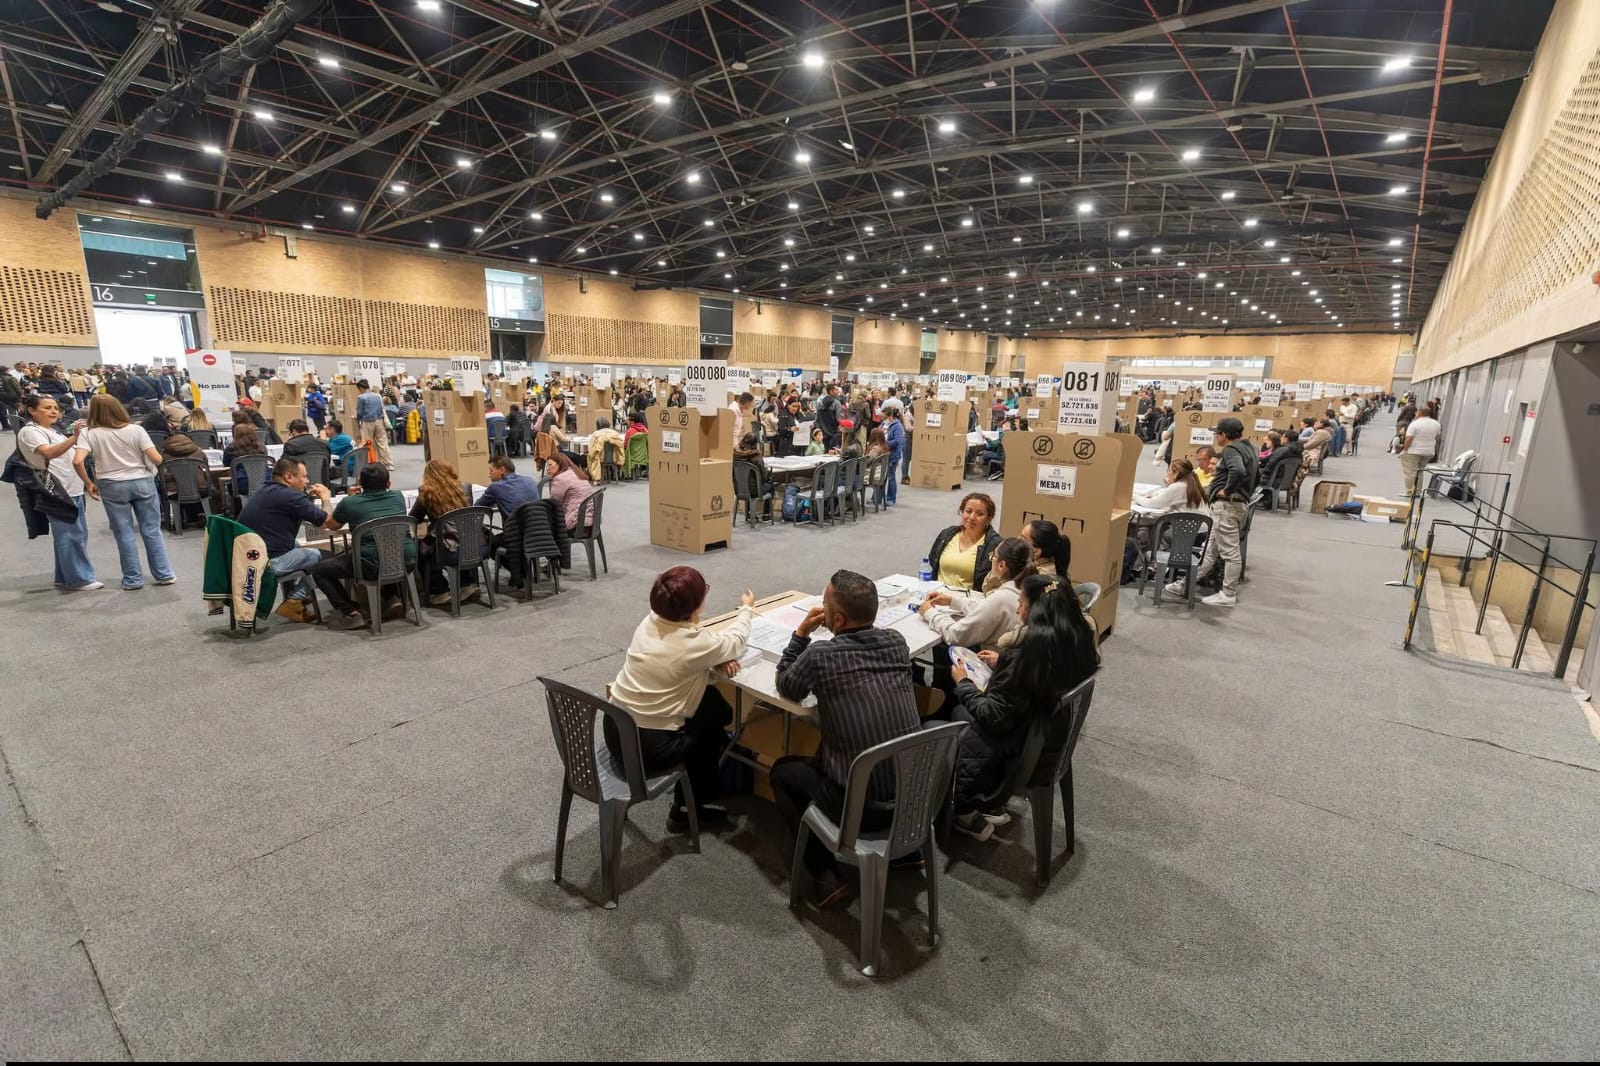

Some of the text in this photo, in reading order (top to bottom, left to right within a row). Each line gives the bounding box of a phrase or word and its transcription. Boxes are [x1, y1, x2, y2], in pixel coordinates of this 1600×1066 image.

[94, 286, 114, 301] 16
[490, 317, 500, 329] 15
[286, 359, 300, 367] 077
[362, 360, 379, 369] 078
[463, 360, 480, 371] 079
[687, 365, 726, 380] 080 080
[940, 373, 955, 383] 089
[1064, 371, 1120, 392] 081 081
[1207, 379, 1230, 391] 090
[1264, 382, 1281, 391] 099
[1039, 480, 1060, 490] MESA
